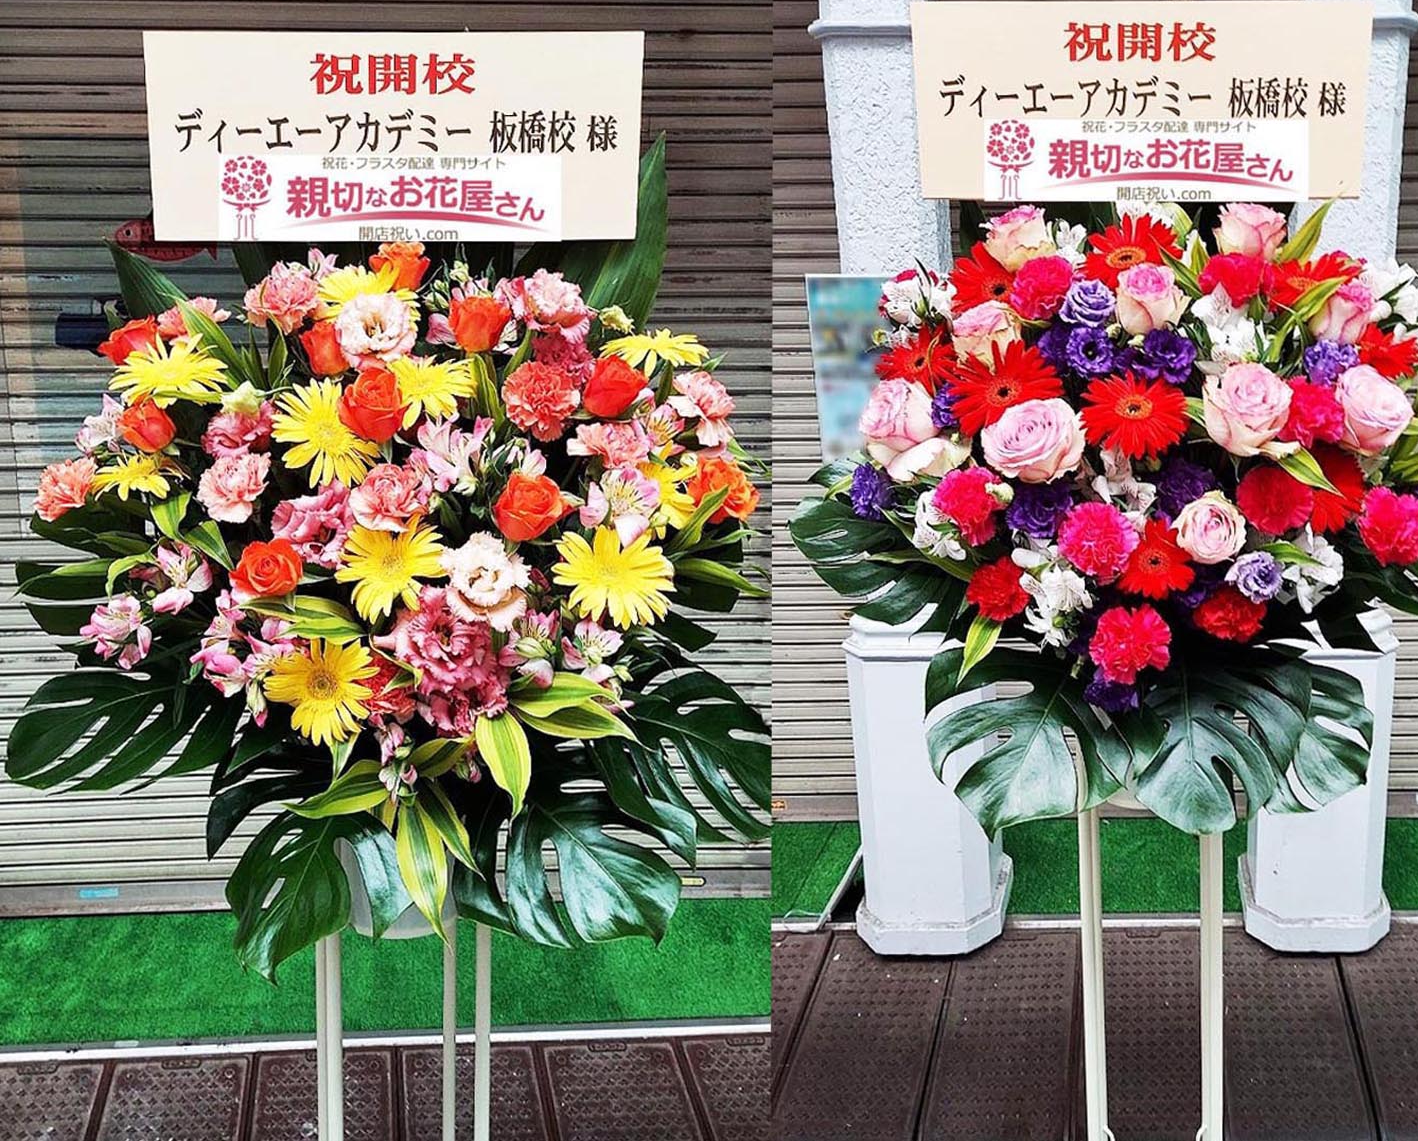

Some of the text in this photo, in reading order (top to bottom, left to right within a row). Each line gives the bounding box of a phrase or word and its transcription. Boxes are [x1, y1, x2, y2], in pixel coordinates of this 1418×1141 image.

[1064, 22, 1216, 62] 祝開校
[310, 53, 475, 95] 祝開校
[940, 75, 1345, 118] ディーエーアカデミー 板橋校 様
[175, 108, 617, 153] ディーエーアカデミー 板橋校 様
